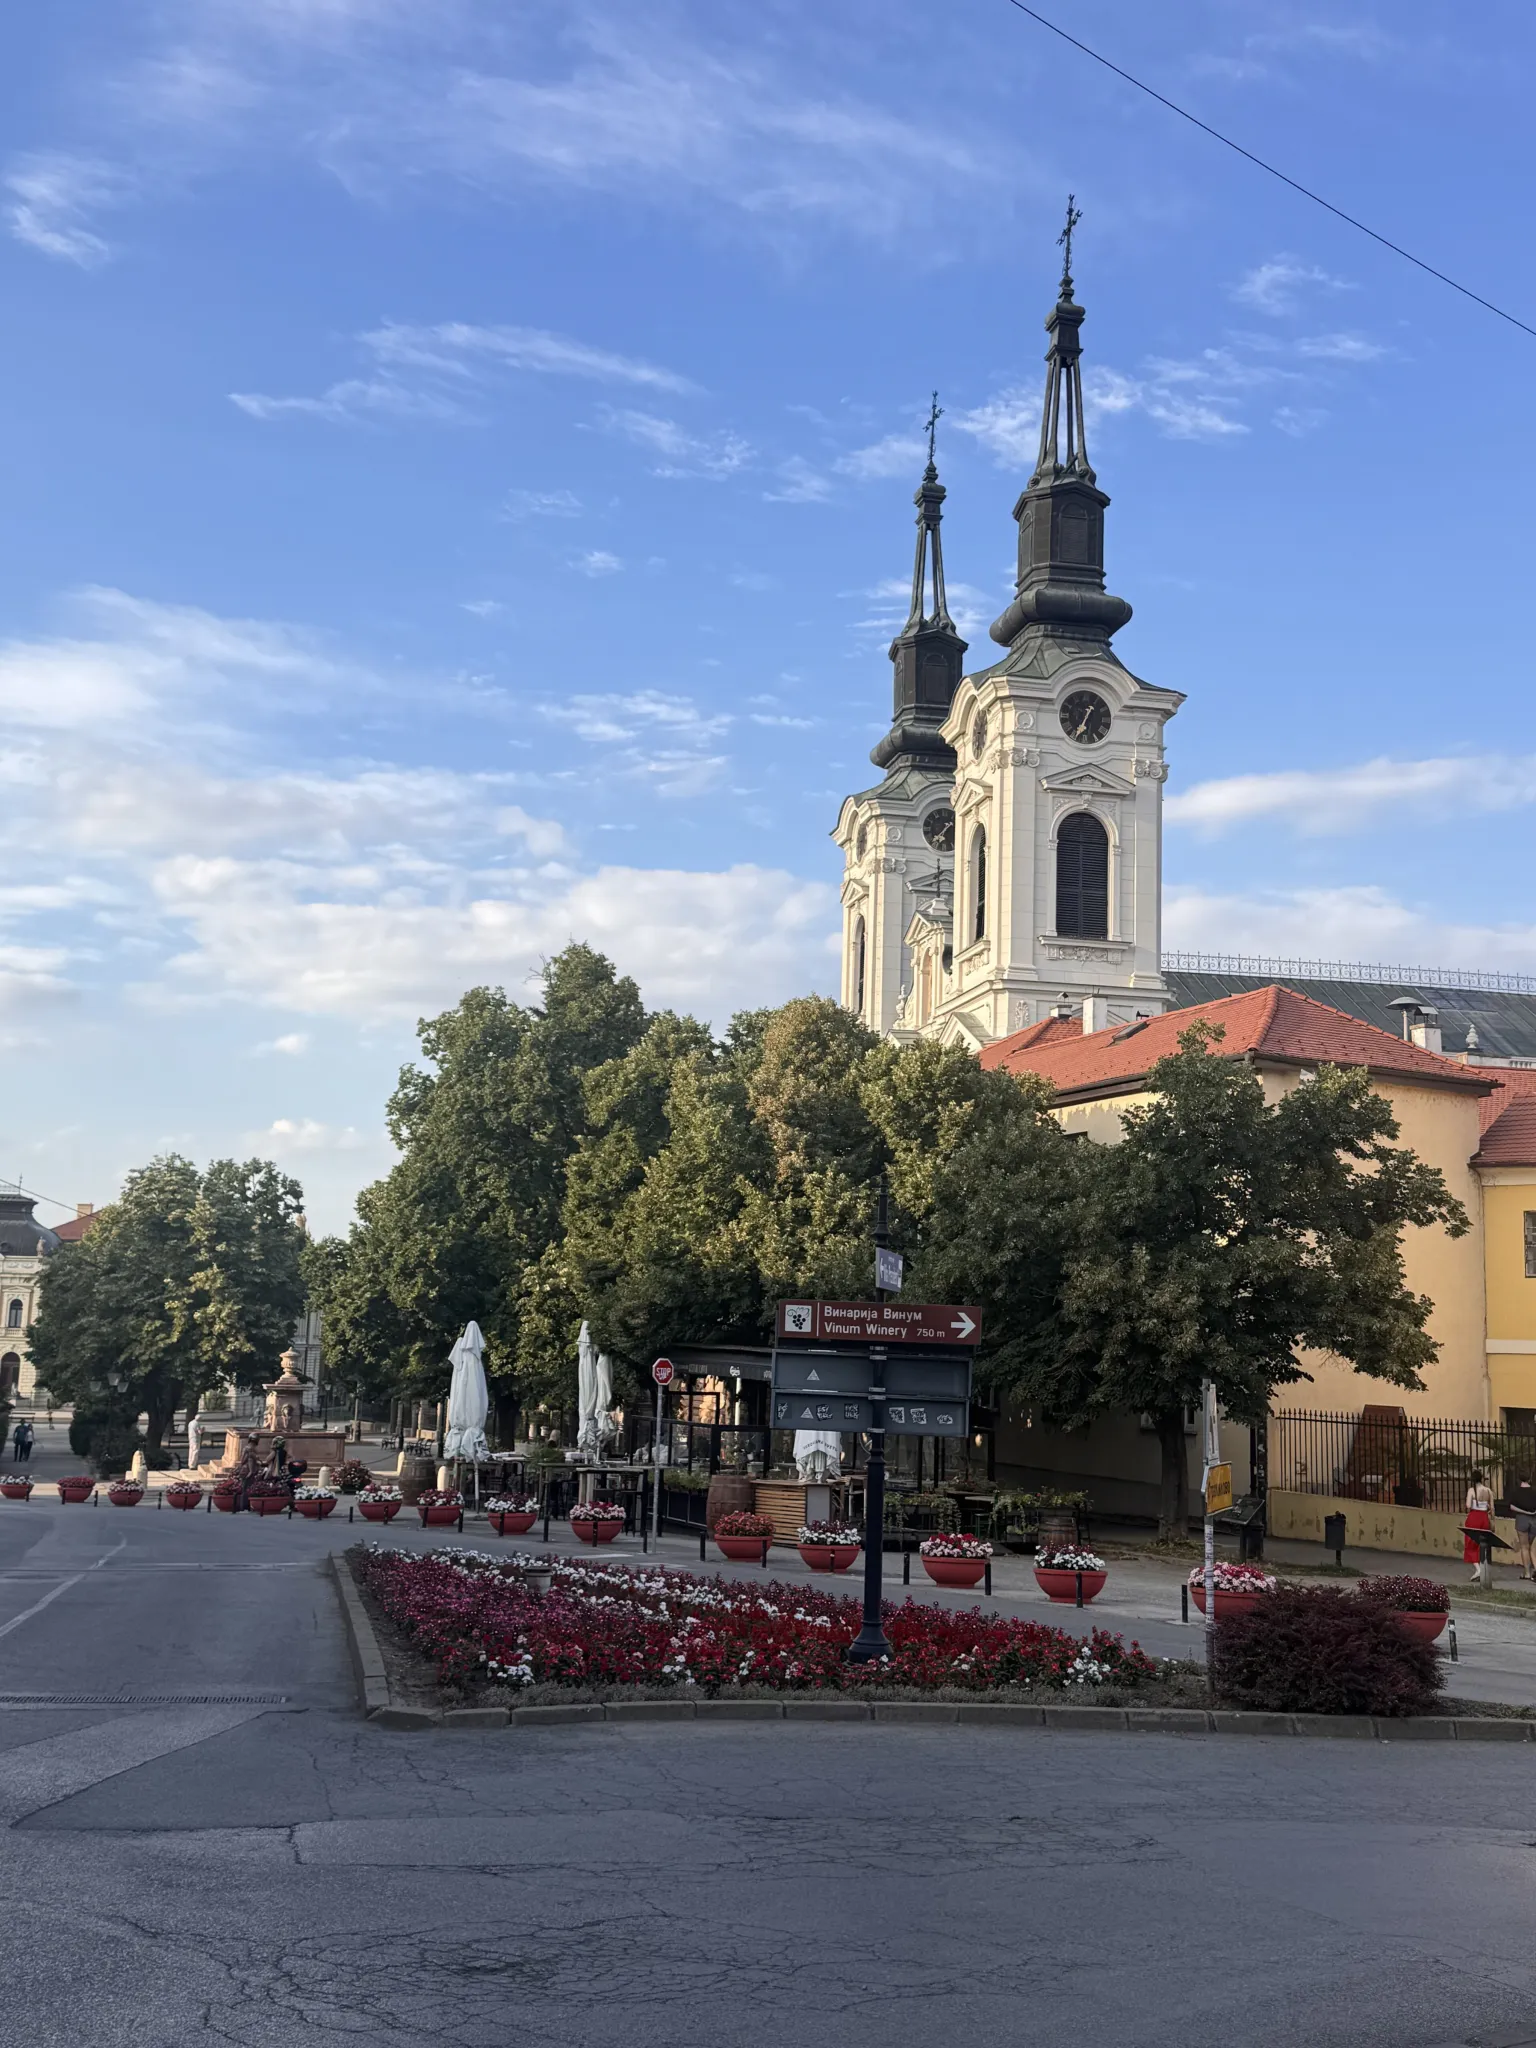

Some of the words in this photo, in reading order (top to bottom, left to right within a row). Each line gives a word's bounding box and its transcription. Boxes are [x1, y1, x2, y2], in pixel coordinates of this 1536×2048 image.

[824, 1306, 878, 1321] Винарија
[884, 1308, 922, 1322] Винум
[824, 1322, 860, 1334] Vinum
[866, 1324, 907, 1338] Winery
[917, 1328, 934, 1337] 750
[656, 1367, 671, 1376] STOP
